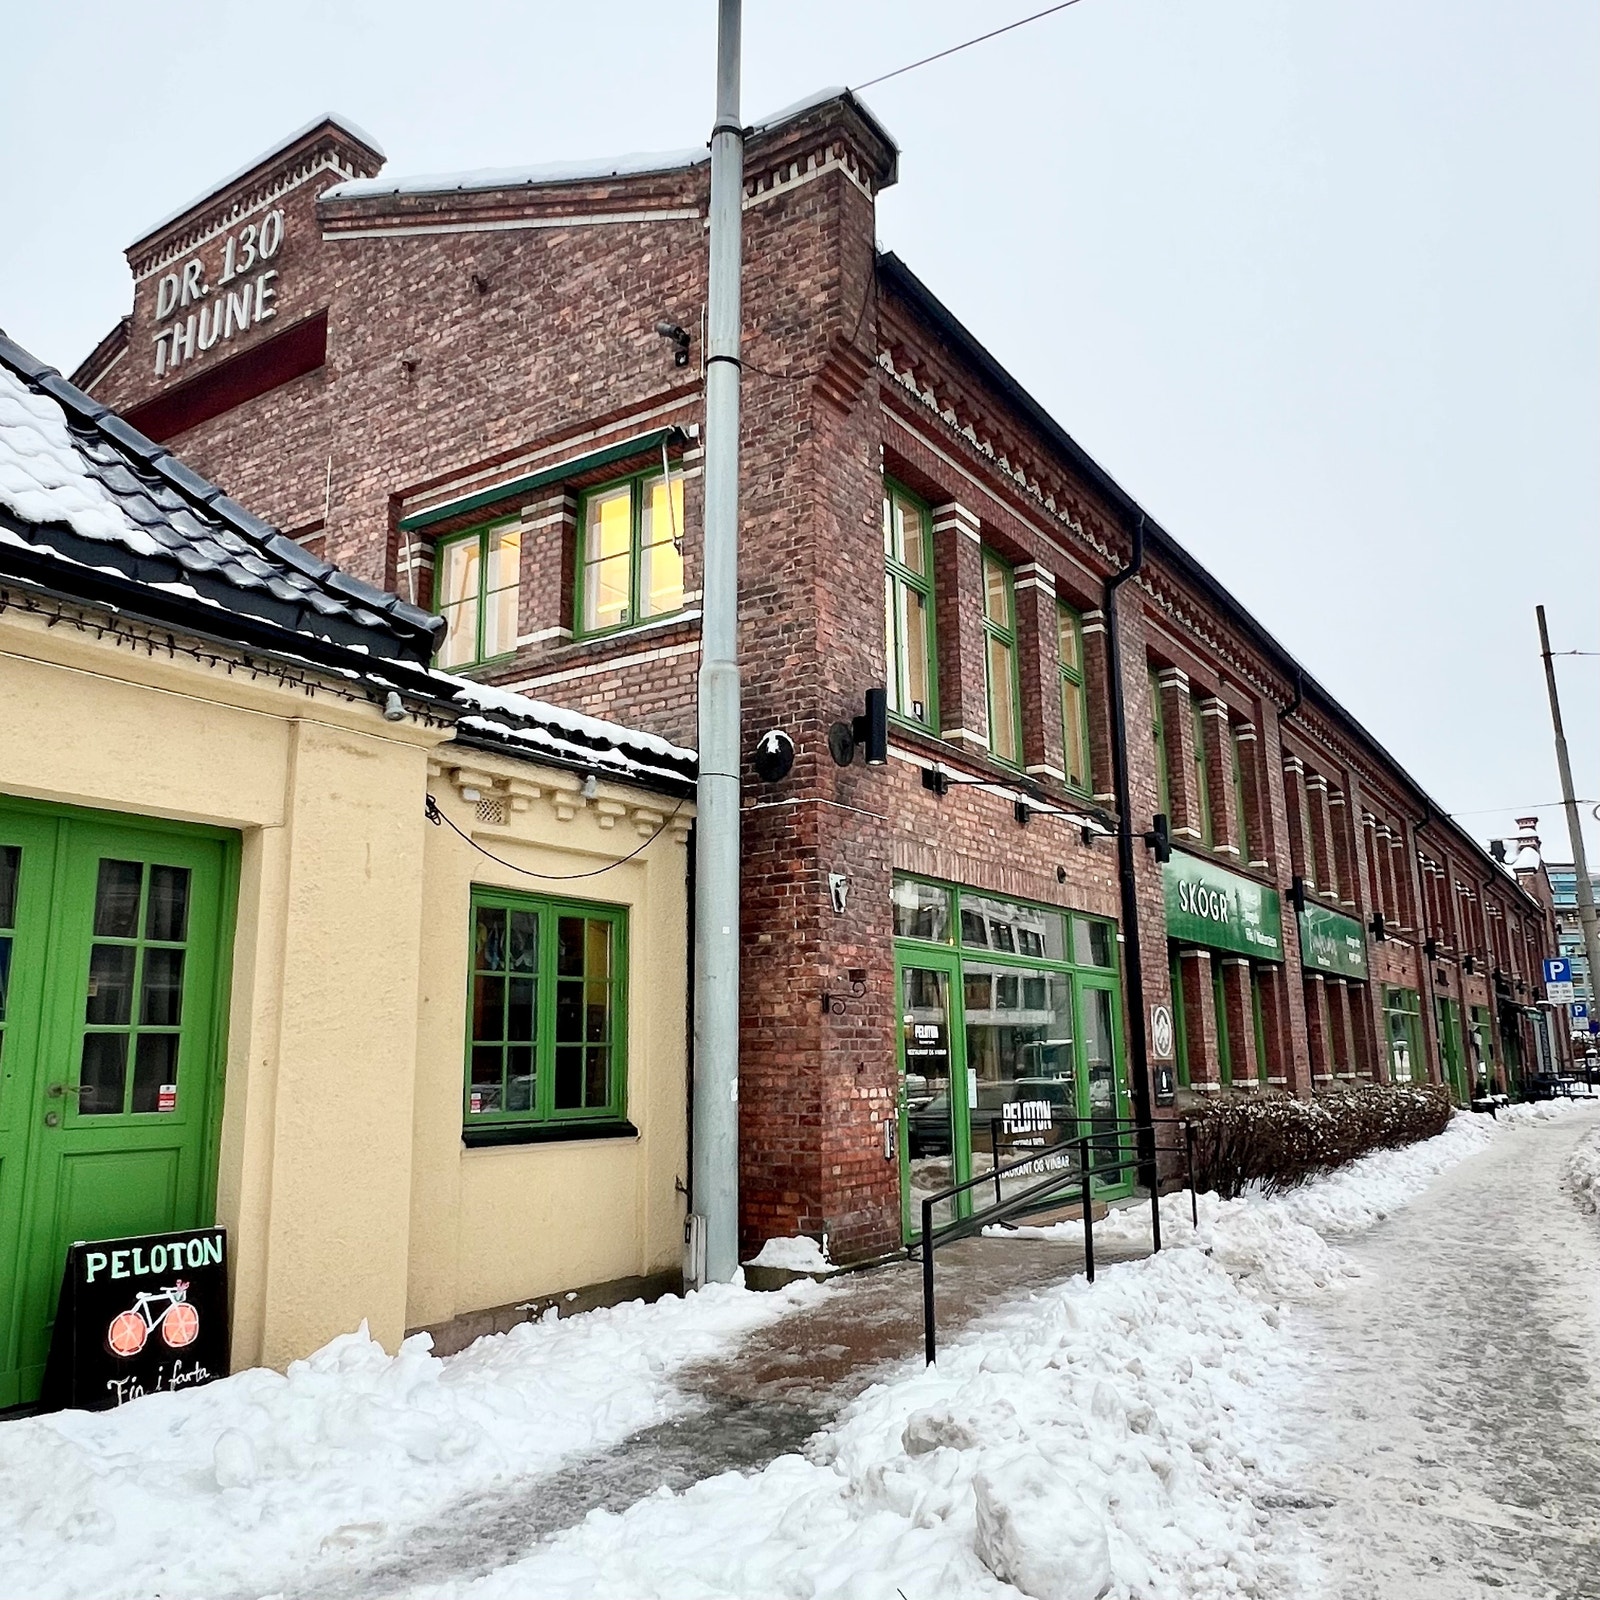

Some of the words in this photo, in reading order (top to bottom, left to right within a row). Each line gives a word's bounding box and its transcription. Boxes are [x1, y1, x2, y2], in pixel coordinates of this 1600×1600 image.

[156, 258, 210, 321] DR.
[218, 210, 283, 286] 130
[153, 270, 279, 376] THUNE
[1178, 878, 1230, 924] SKÓGR
[1549, 961, 1565, 980] P
[1002, 1100, 1053, 1135] PELOTON
[1033, 1159, 1045, 1174] OG
[85, 1234, 223, 1283] PELOTON
[106, 1375, 145, 1407] Fin
[155, 1365, 164, 1391] i
